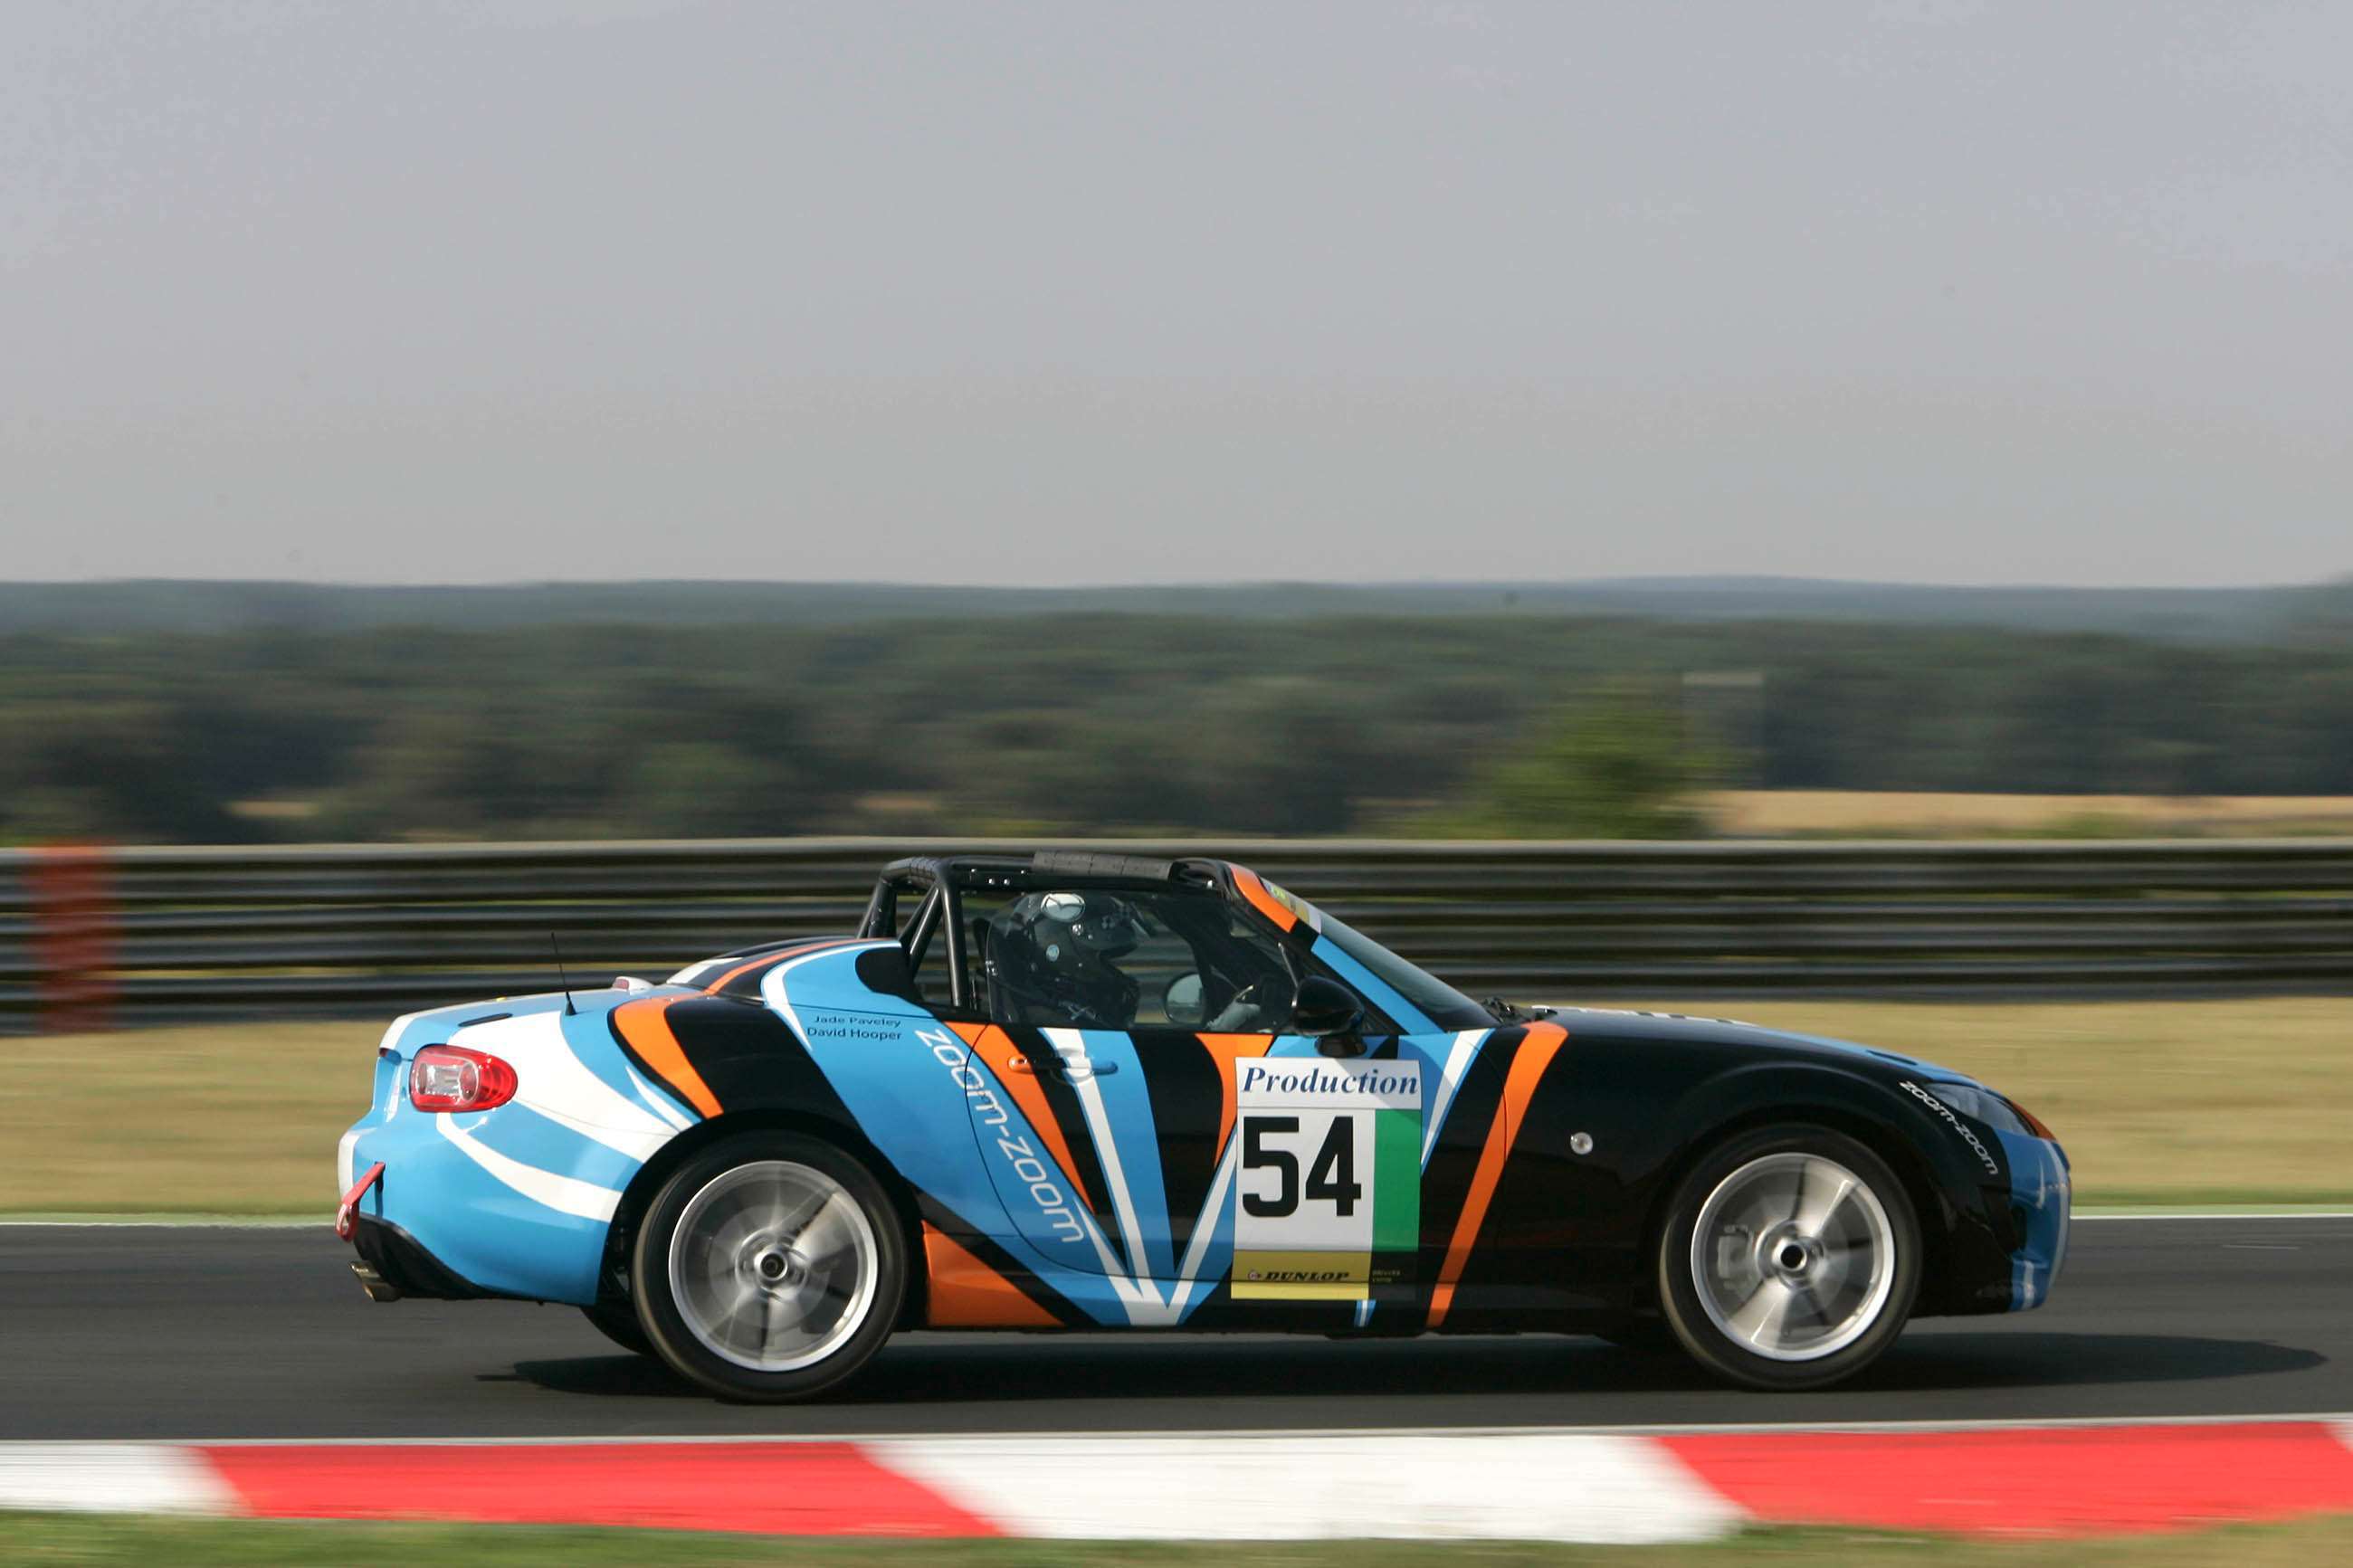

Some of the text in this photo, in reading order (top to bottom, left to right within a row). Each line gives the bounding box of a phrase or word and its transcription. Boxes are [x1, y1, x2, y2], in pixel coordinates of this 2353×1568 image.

[807, 1027, 901, 1041] David Hooper
[850, 1017, 900, 1028] Paveley
[1243, 1067, 1418, 1095] Production
[914, 1029, 1084, 1243] zoom-zoom
[1900, 1080, 1998, 1174] zoom-zoom
[1243, 1117, 1361, 1217] 54
[1266, 1271, 1349, 1281] DUNLOP
